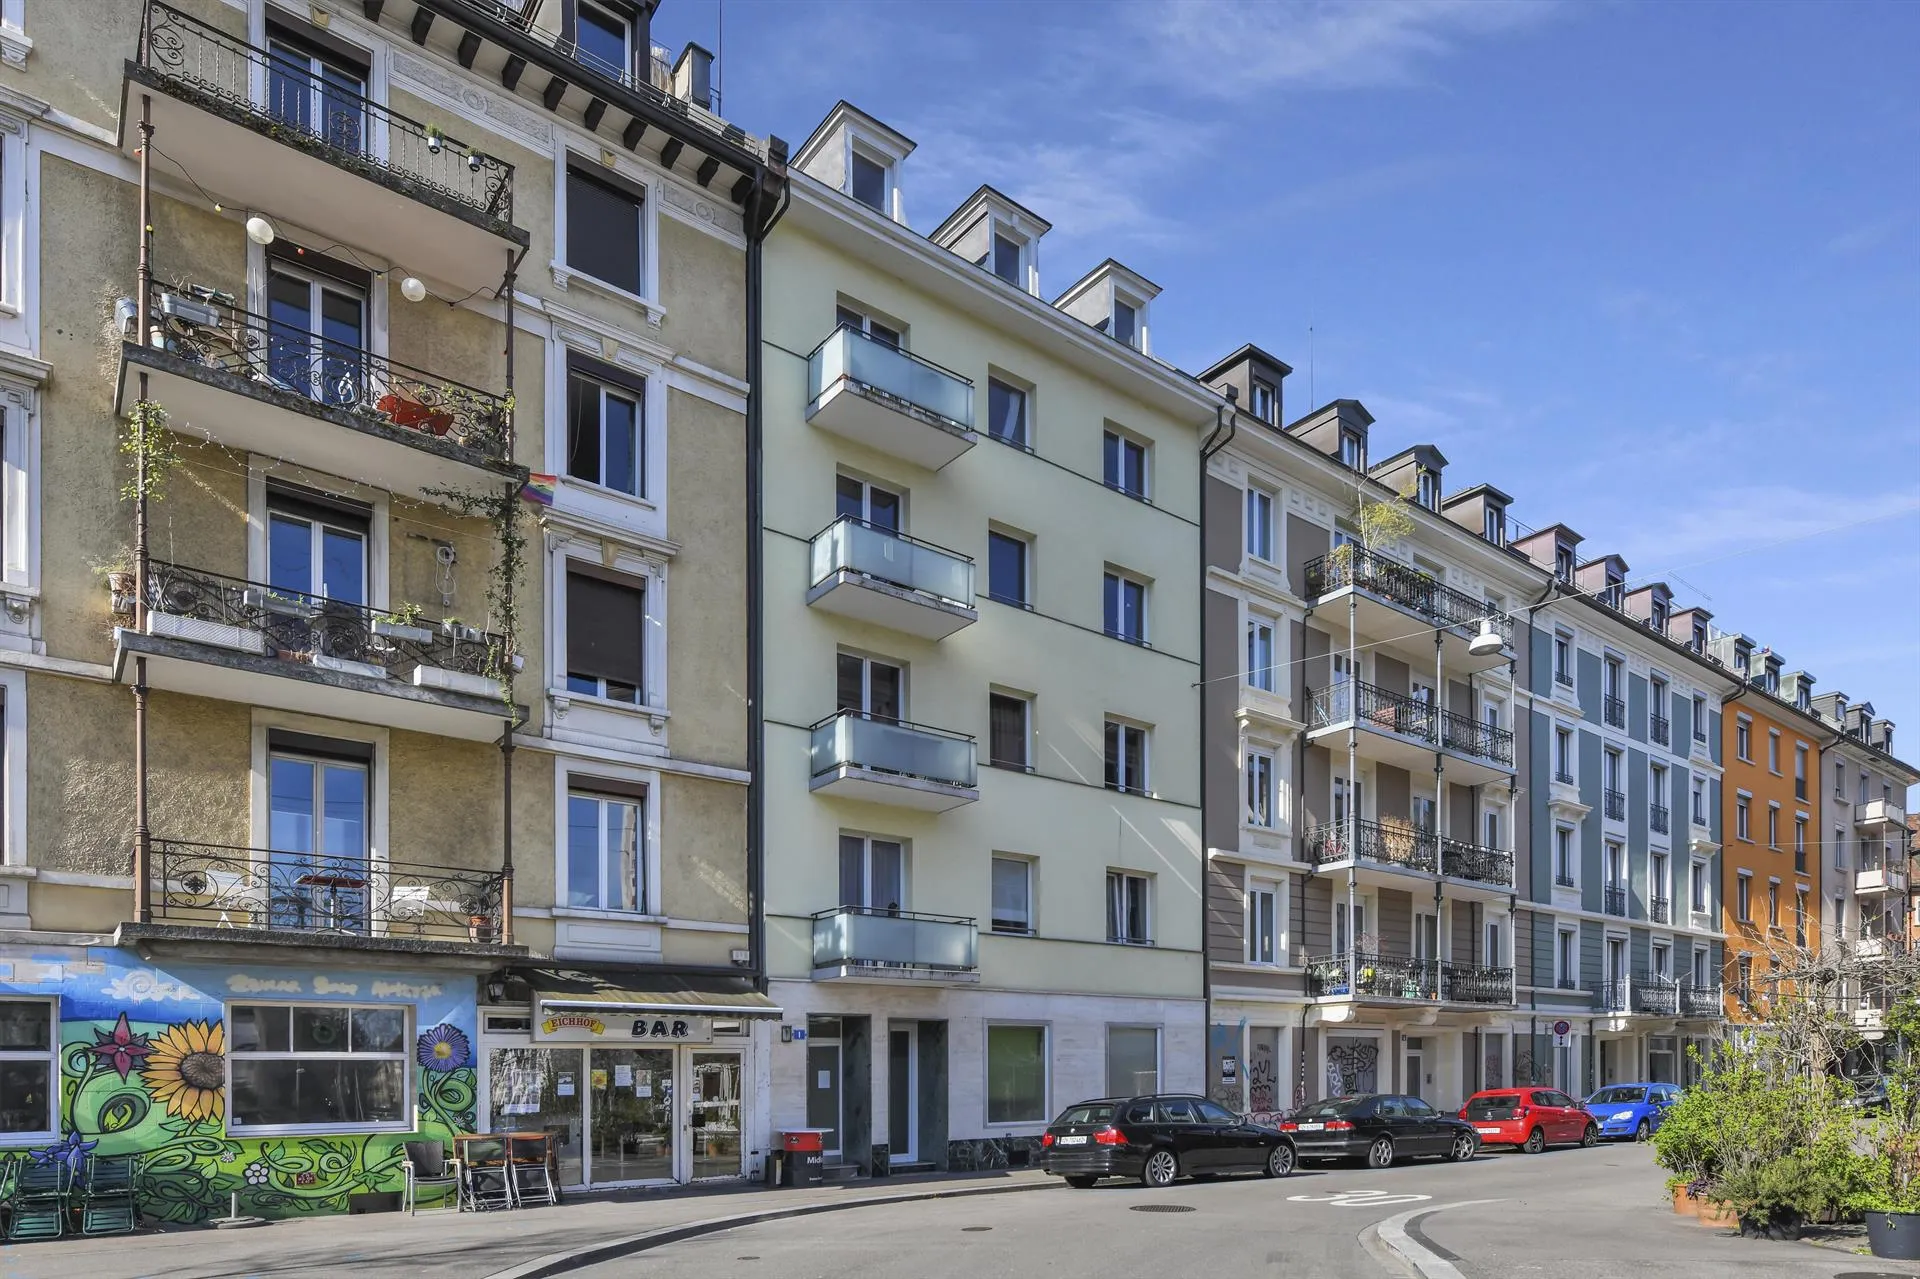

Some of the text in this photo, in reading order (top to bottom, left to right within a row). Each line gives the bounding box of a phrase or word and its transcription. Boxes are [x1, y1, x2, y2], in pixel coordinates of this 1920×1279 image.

[551, 1017, 597, 1028] EICHHOF
[631, 1020, 688, 1038] BAR
[1286, 1190, 1433, 1207] 30
